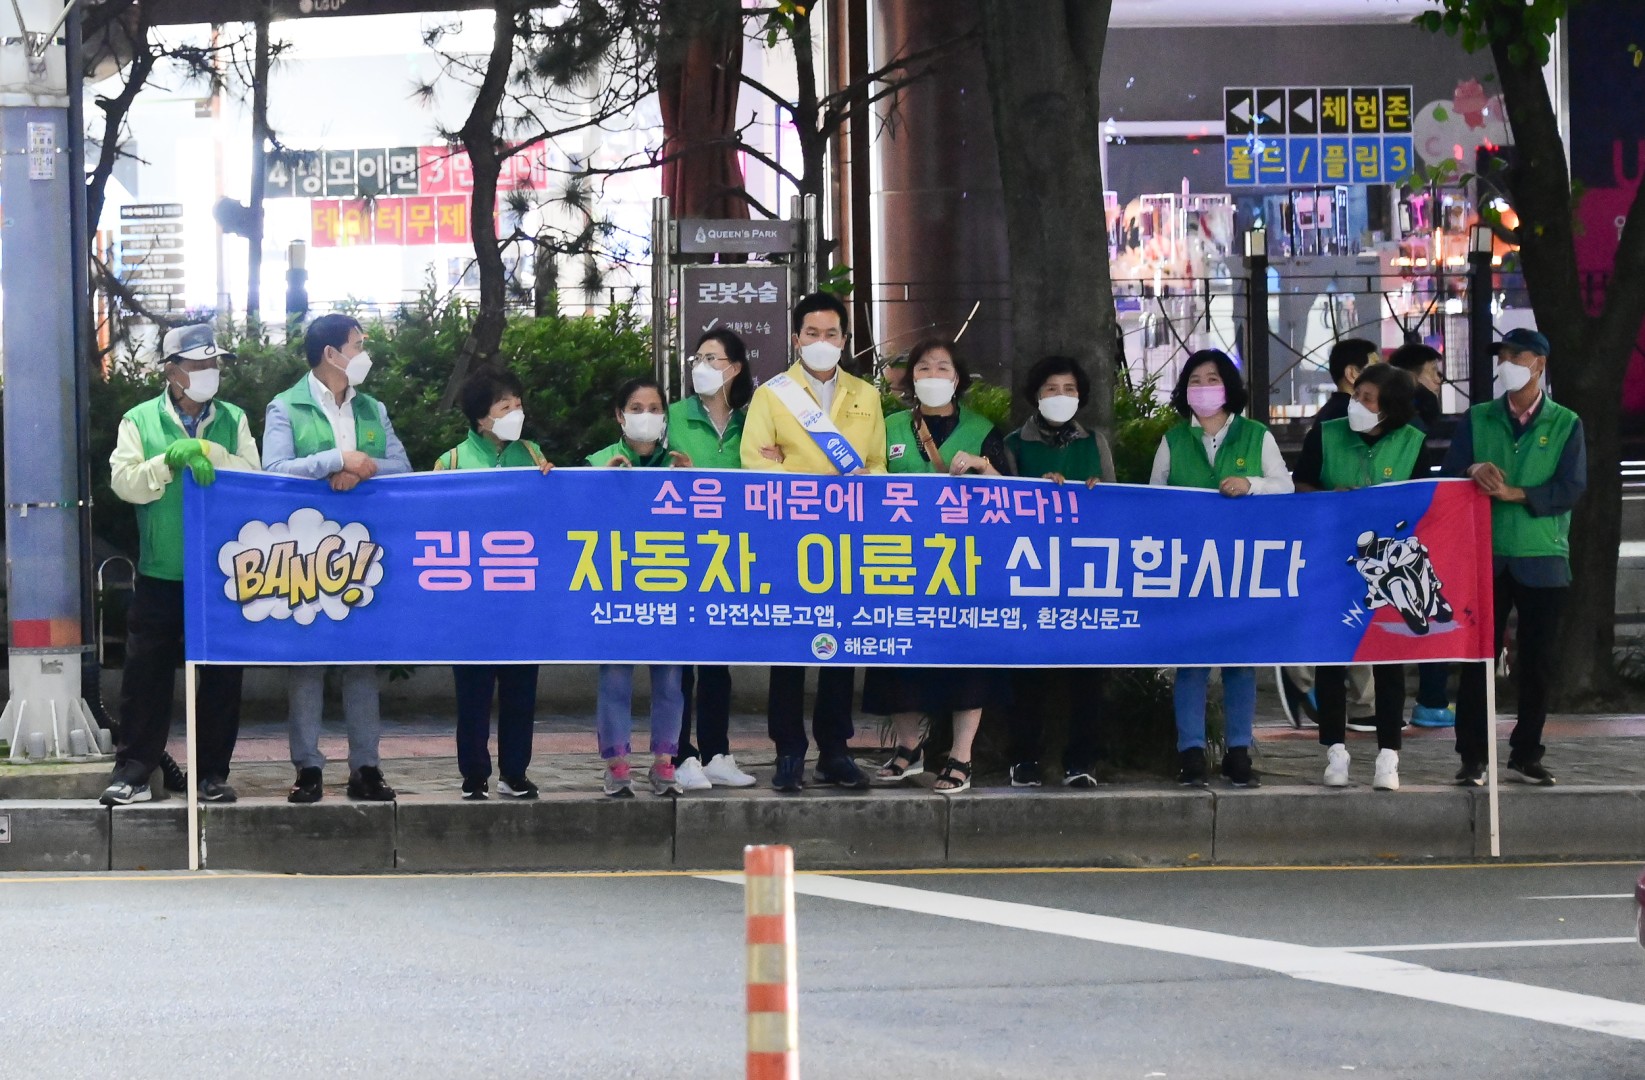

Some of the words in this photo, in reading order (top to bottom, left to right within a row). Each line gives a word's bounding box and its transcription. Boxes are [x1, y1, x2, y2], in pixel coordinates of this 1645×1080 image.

[1322, 95, 1410, 129] 체험존
[313, 203, 466, 240] 데이터무제
[708, 229, 750, 239] QUEEN'S
[751, 229, 778, 238] PARK
[698, 281, 778, 304] 로봇수술
[756, 321, 771, 334] 수술
[650, 479, 725, 519] 소음
[745, 480, 864, 522] 때문에
[881, 482, 919, 523] 못
[935, 484, 1079, 524] 살겠다!!
[233, 534, 379, 609] BANG!
[412, 530, 539, 592] 굉음
[797, 532, 982, 596] 이륜차
[1005, 535, 1306, 598] 신고합시다
[590, 602, 677, 625] 신고방법
[705, 603, 842, 629] 안전신문고앱,
[851, 605, 1028, 630] 스마트국민제보앱,
[1036, 607, 1141, 630] 환경신문고
[844, 637, 913, 656] 해운대구
